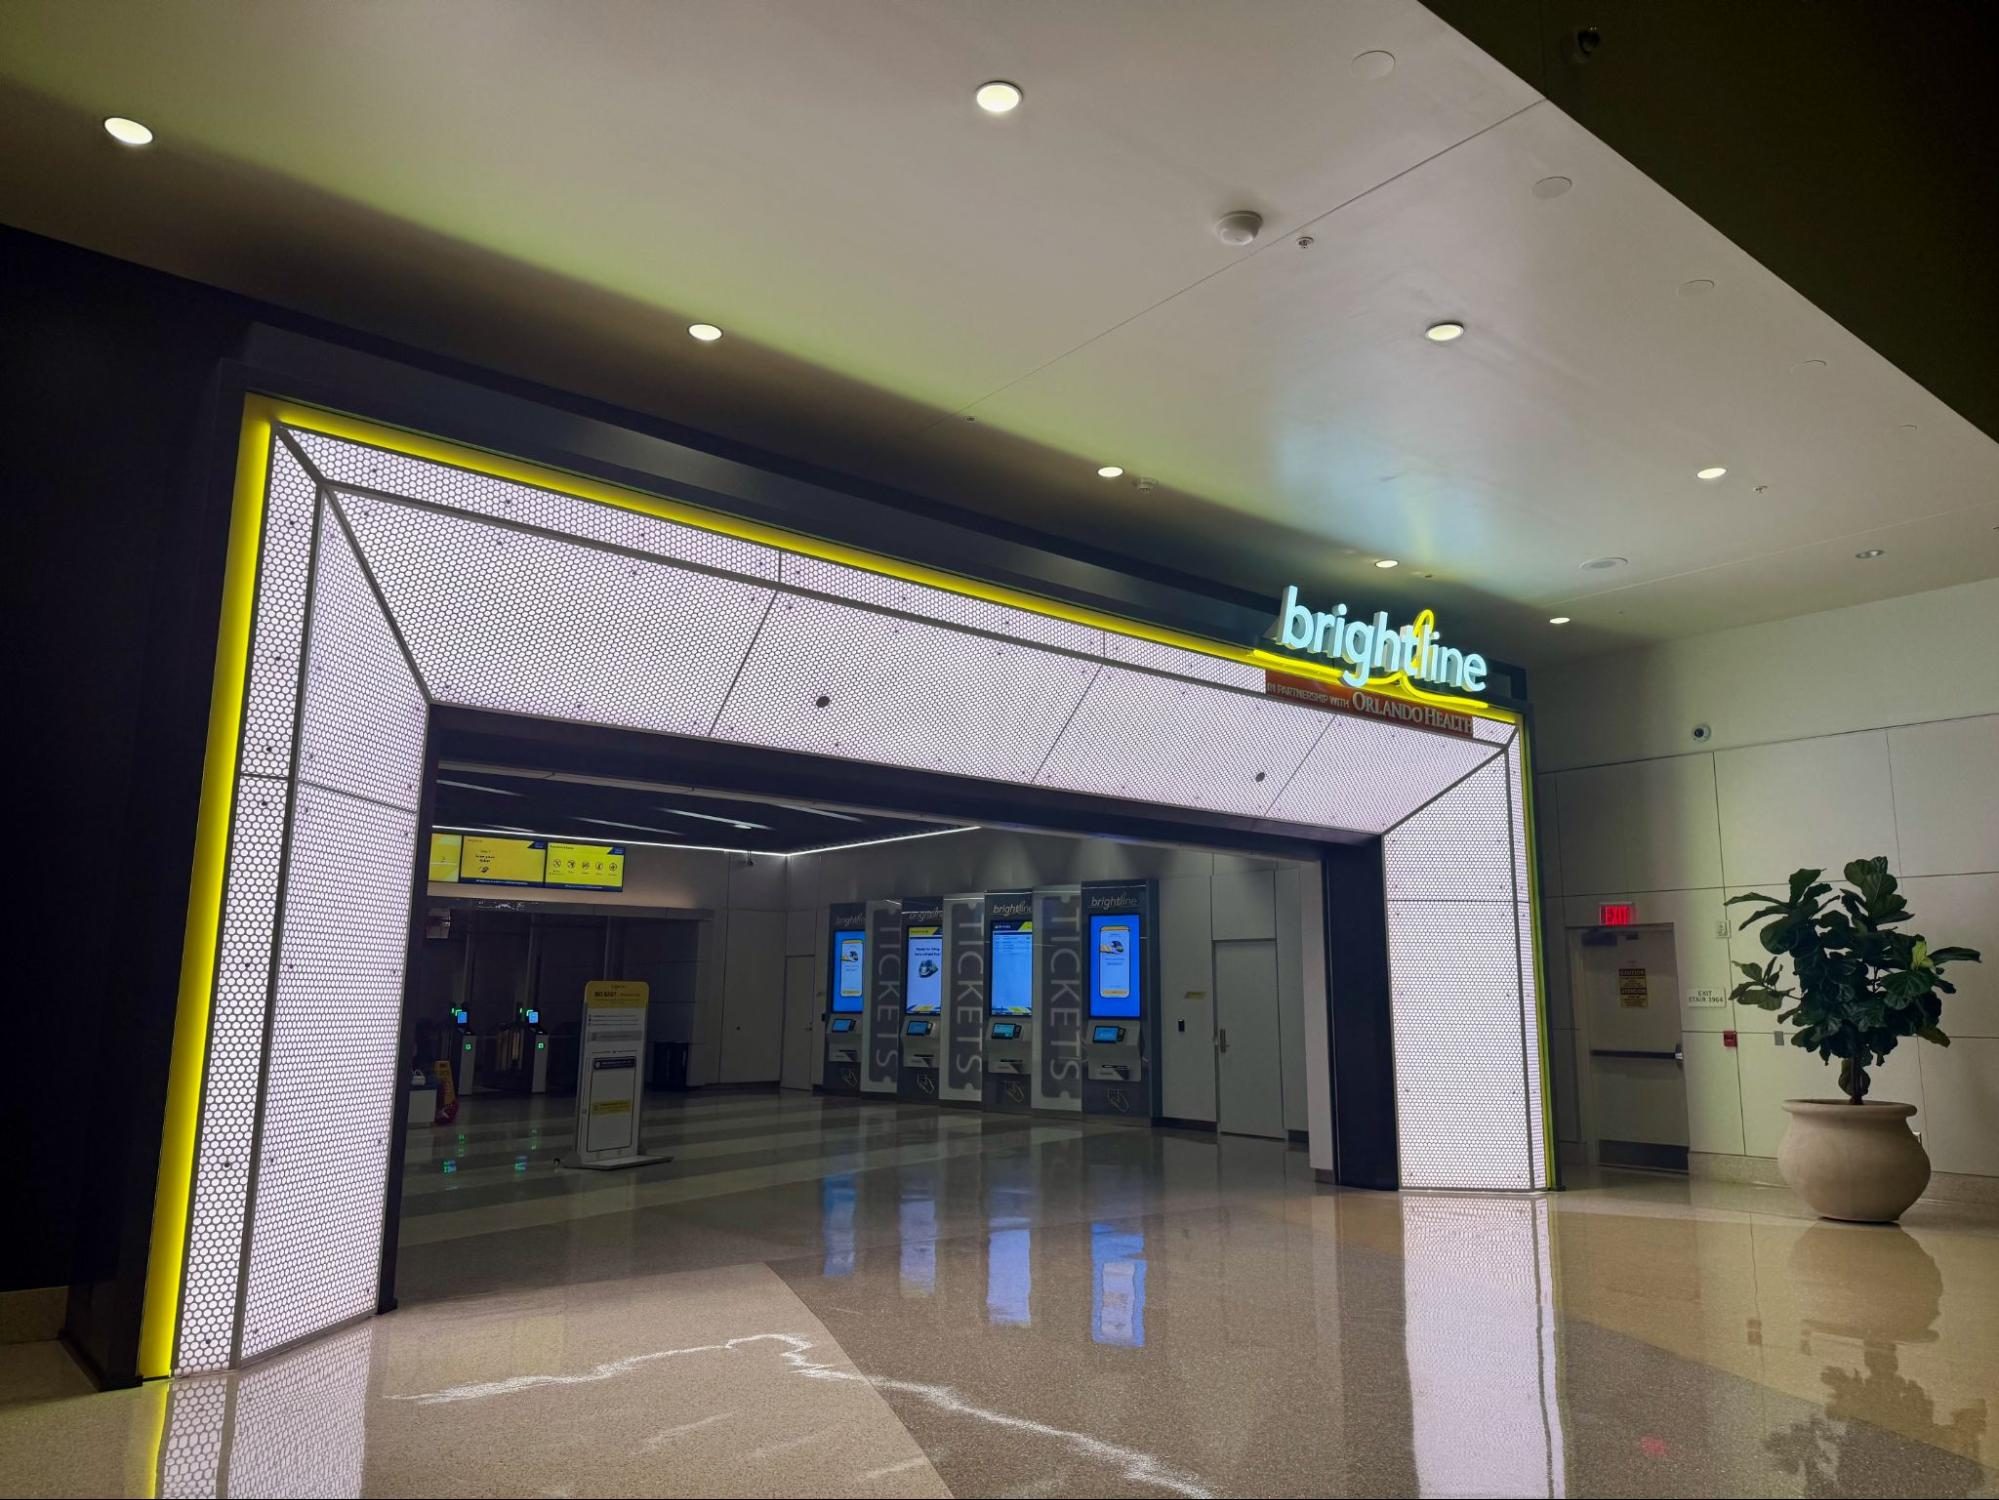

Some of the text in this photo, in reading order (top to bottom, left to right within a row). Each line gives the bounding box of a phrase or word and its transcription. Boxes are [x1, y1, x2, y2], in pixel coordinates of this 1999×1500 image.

[1278, 584, 1487, 692] brightline
[1277, 684, 1329, 704] PARTNERSHIP
[1330, 695, 1350, 709] WITH
[1352, 691, 1423, 723] ORLANDO
[1424, 706, 1473, 734] HEALTH
[1604, 905, 1631, 926] EXIT
[957, 912, 984, 1073] TICKETS
[1050, 907, 1080, 1080] TICKETS
